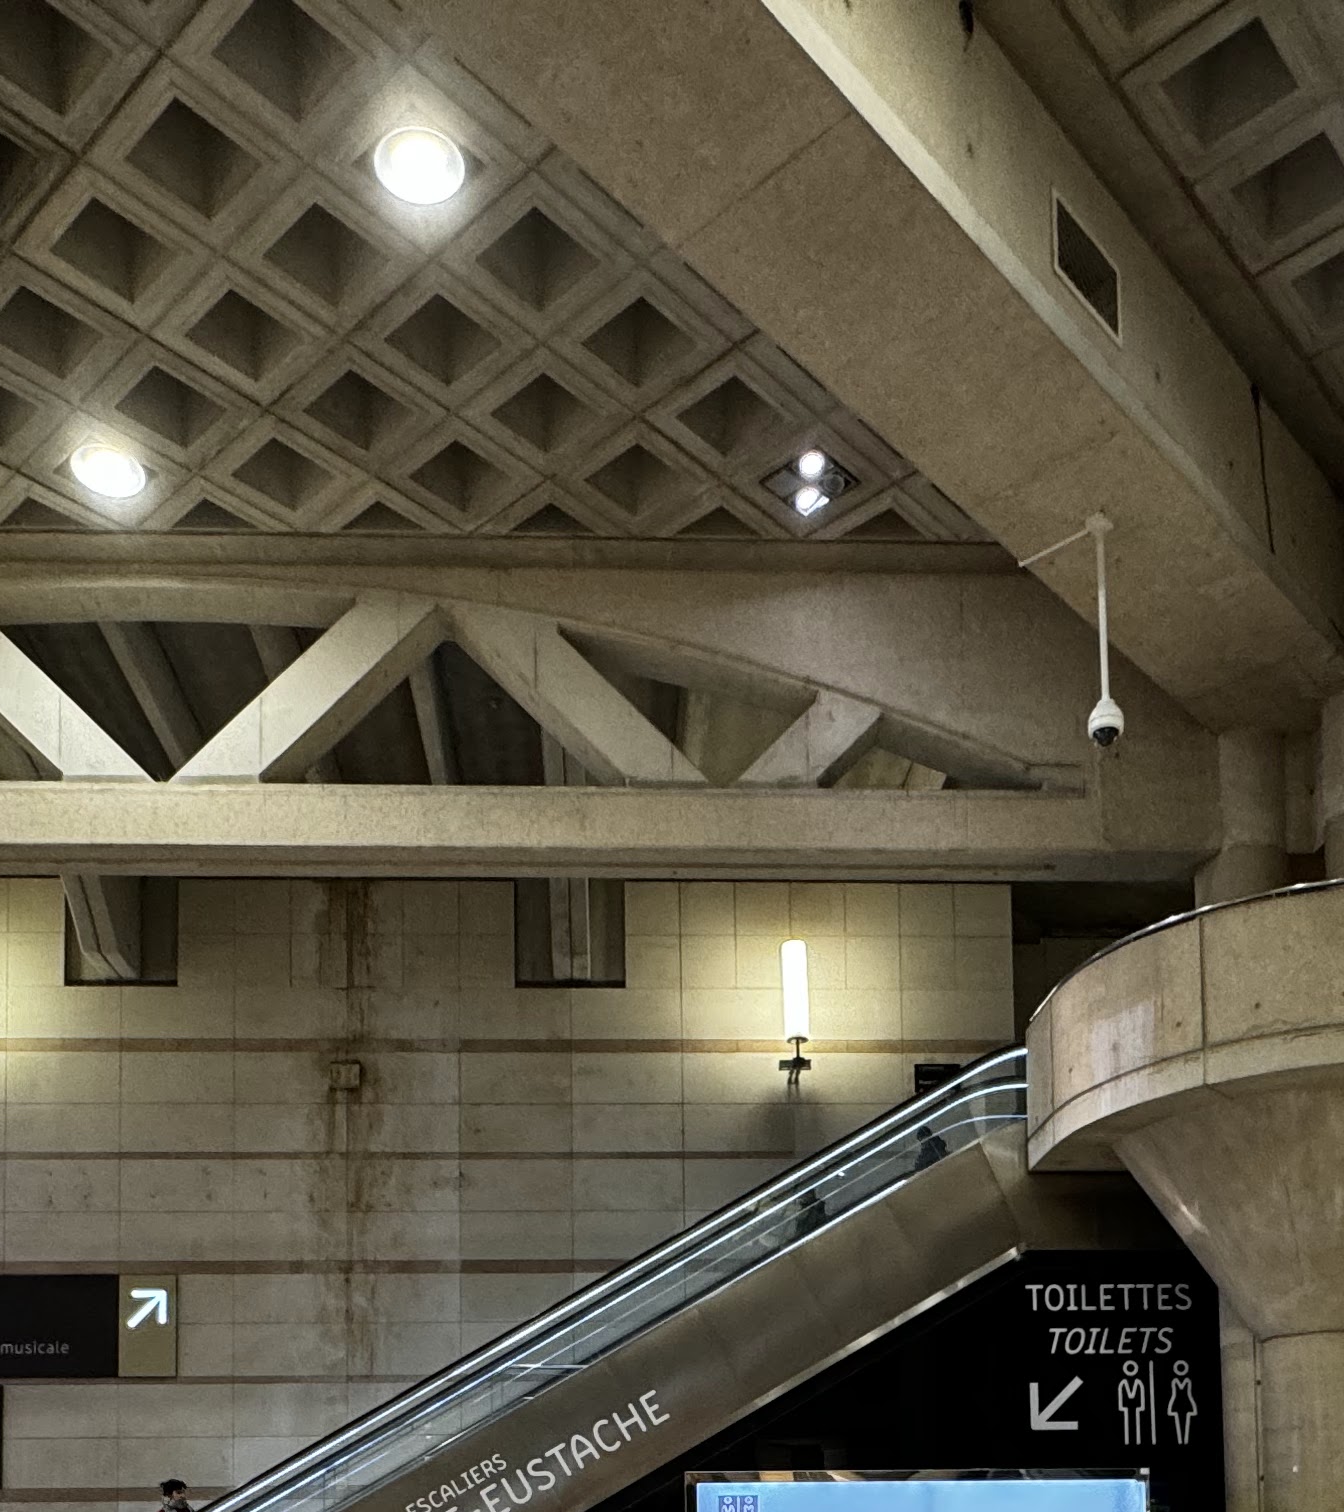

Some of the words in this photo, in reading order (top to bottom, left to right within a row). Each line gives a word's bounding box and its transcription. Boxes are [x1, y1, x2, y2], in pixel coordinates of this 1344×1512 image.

[1024, 1283, 1193, 1312] TOILETTES
[0, 1341, 70, 1354] musicale
[1048, 1326, 1174, 1355] TOILETS
